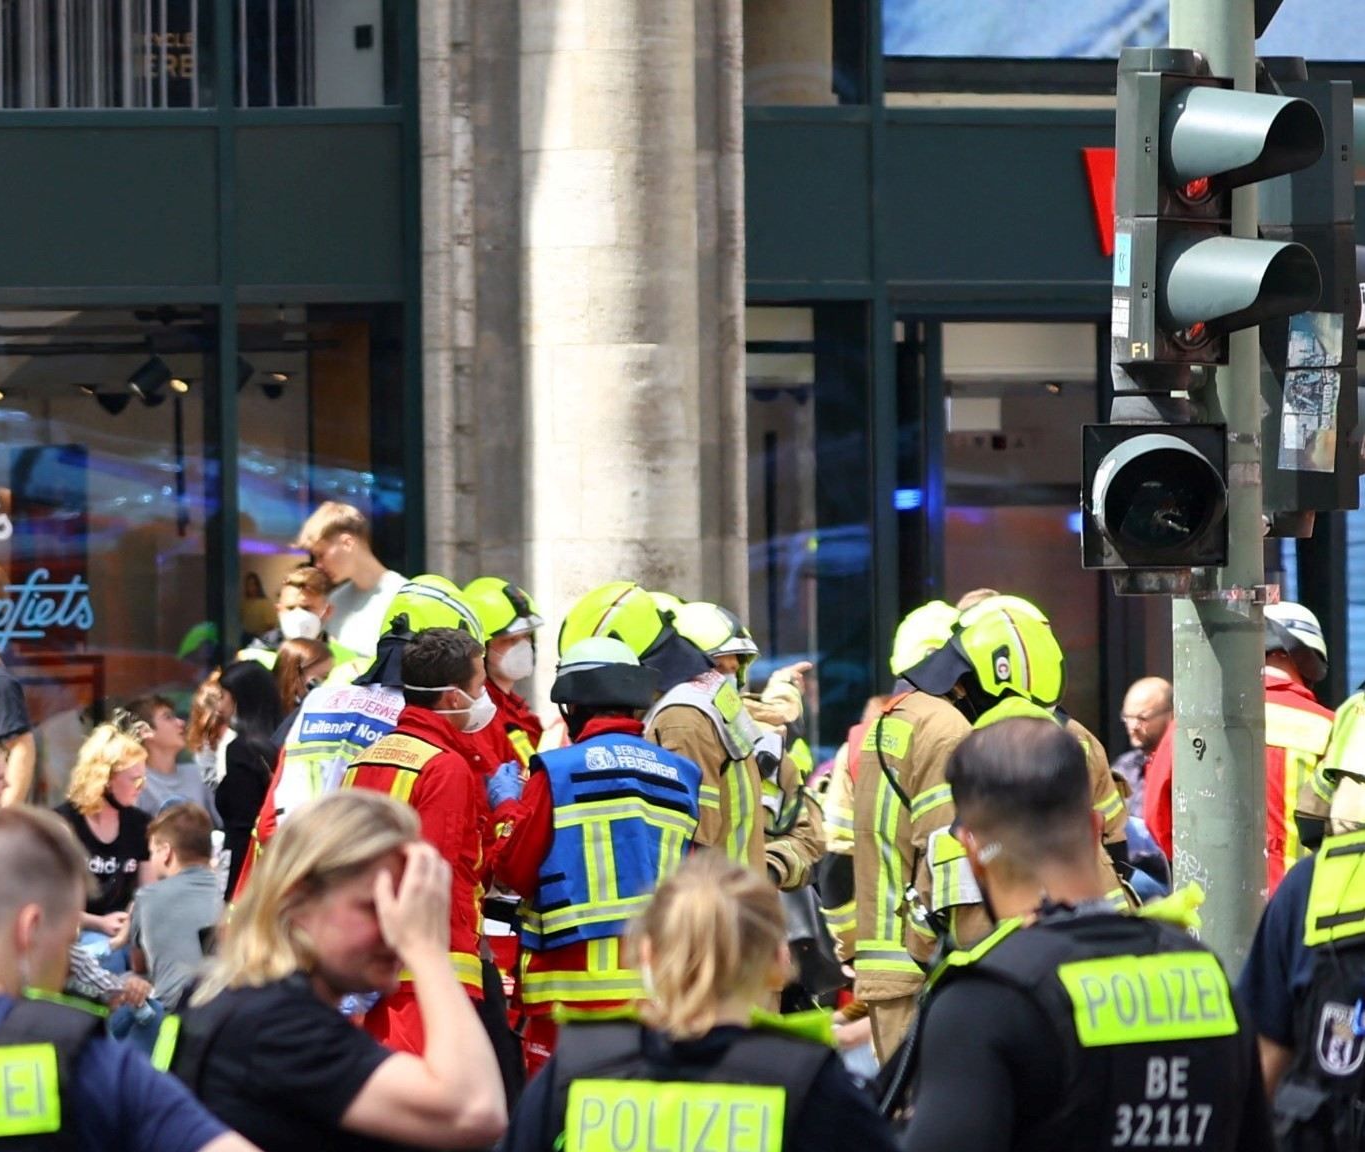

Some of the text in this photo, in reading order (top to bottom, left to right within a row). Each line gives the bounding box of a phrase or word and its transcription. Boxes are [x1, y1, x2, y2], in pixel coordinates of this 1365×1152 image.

[1131, 342, 1149, 359] F1
[1081, 968, 1227, 1028] POLIZEI
[1146, 1057, 1189, 1099] BE
[1112, 1103, 1213, 1148] 32117
